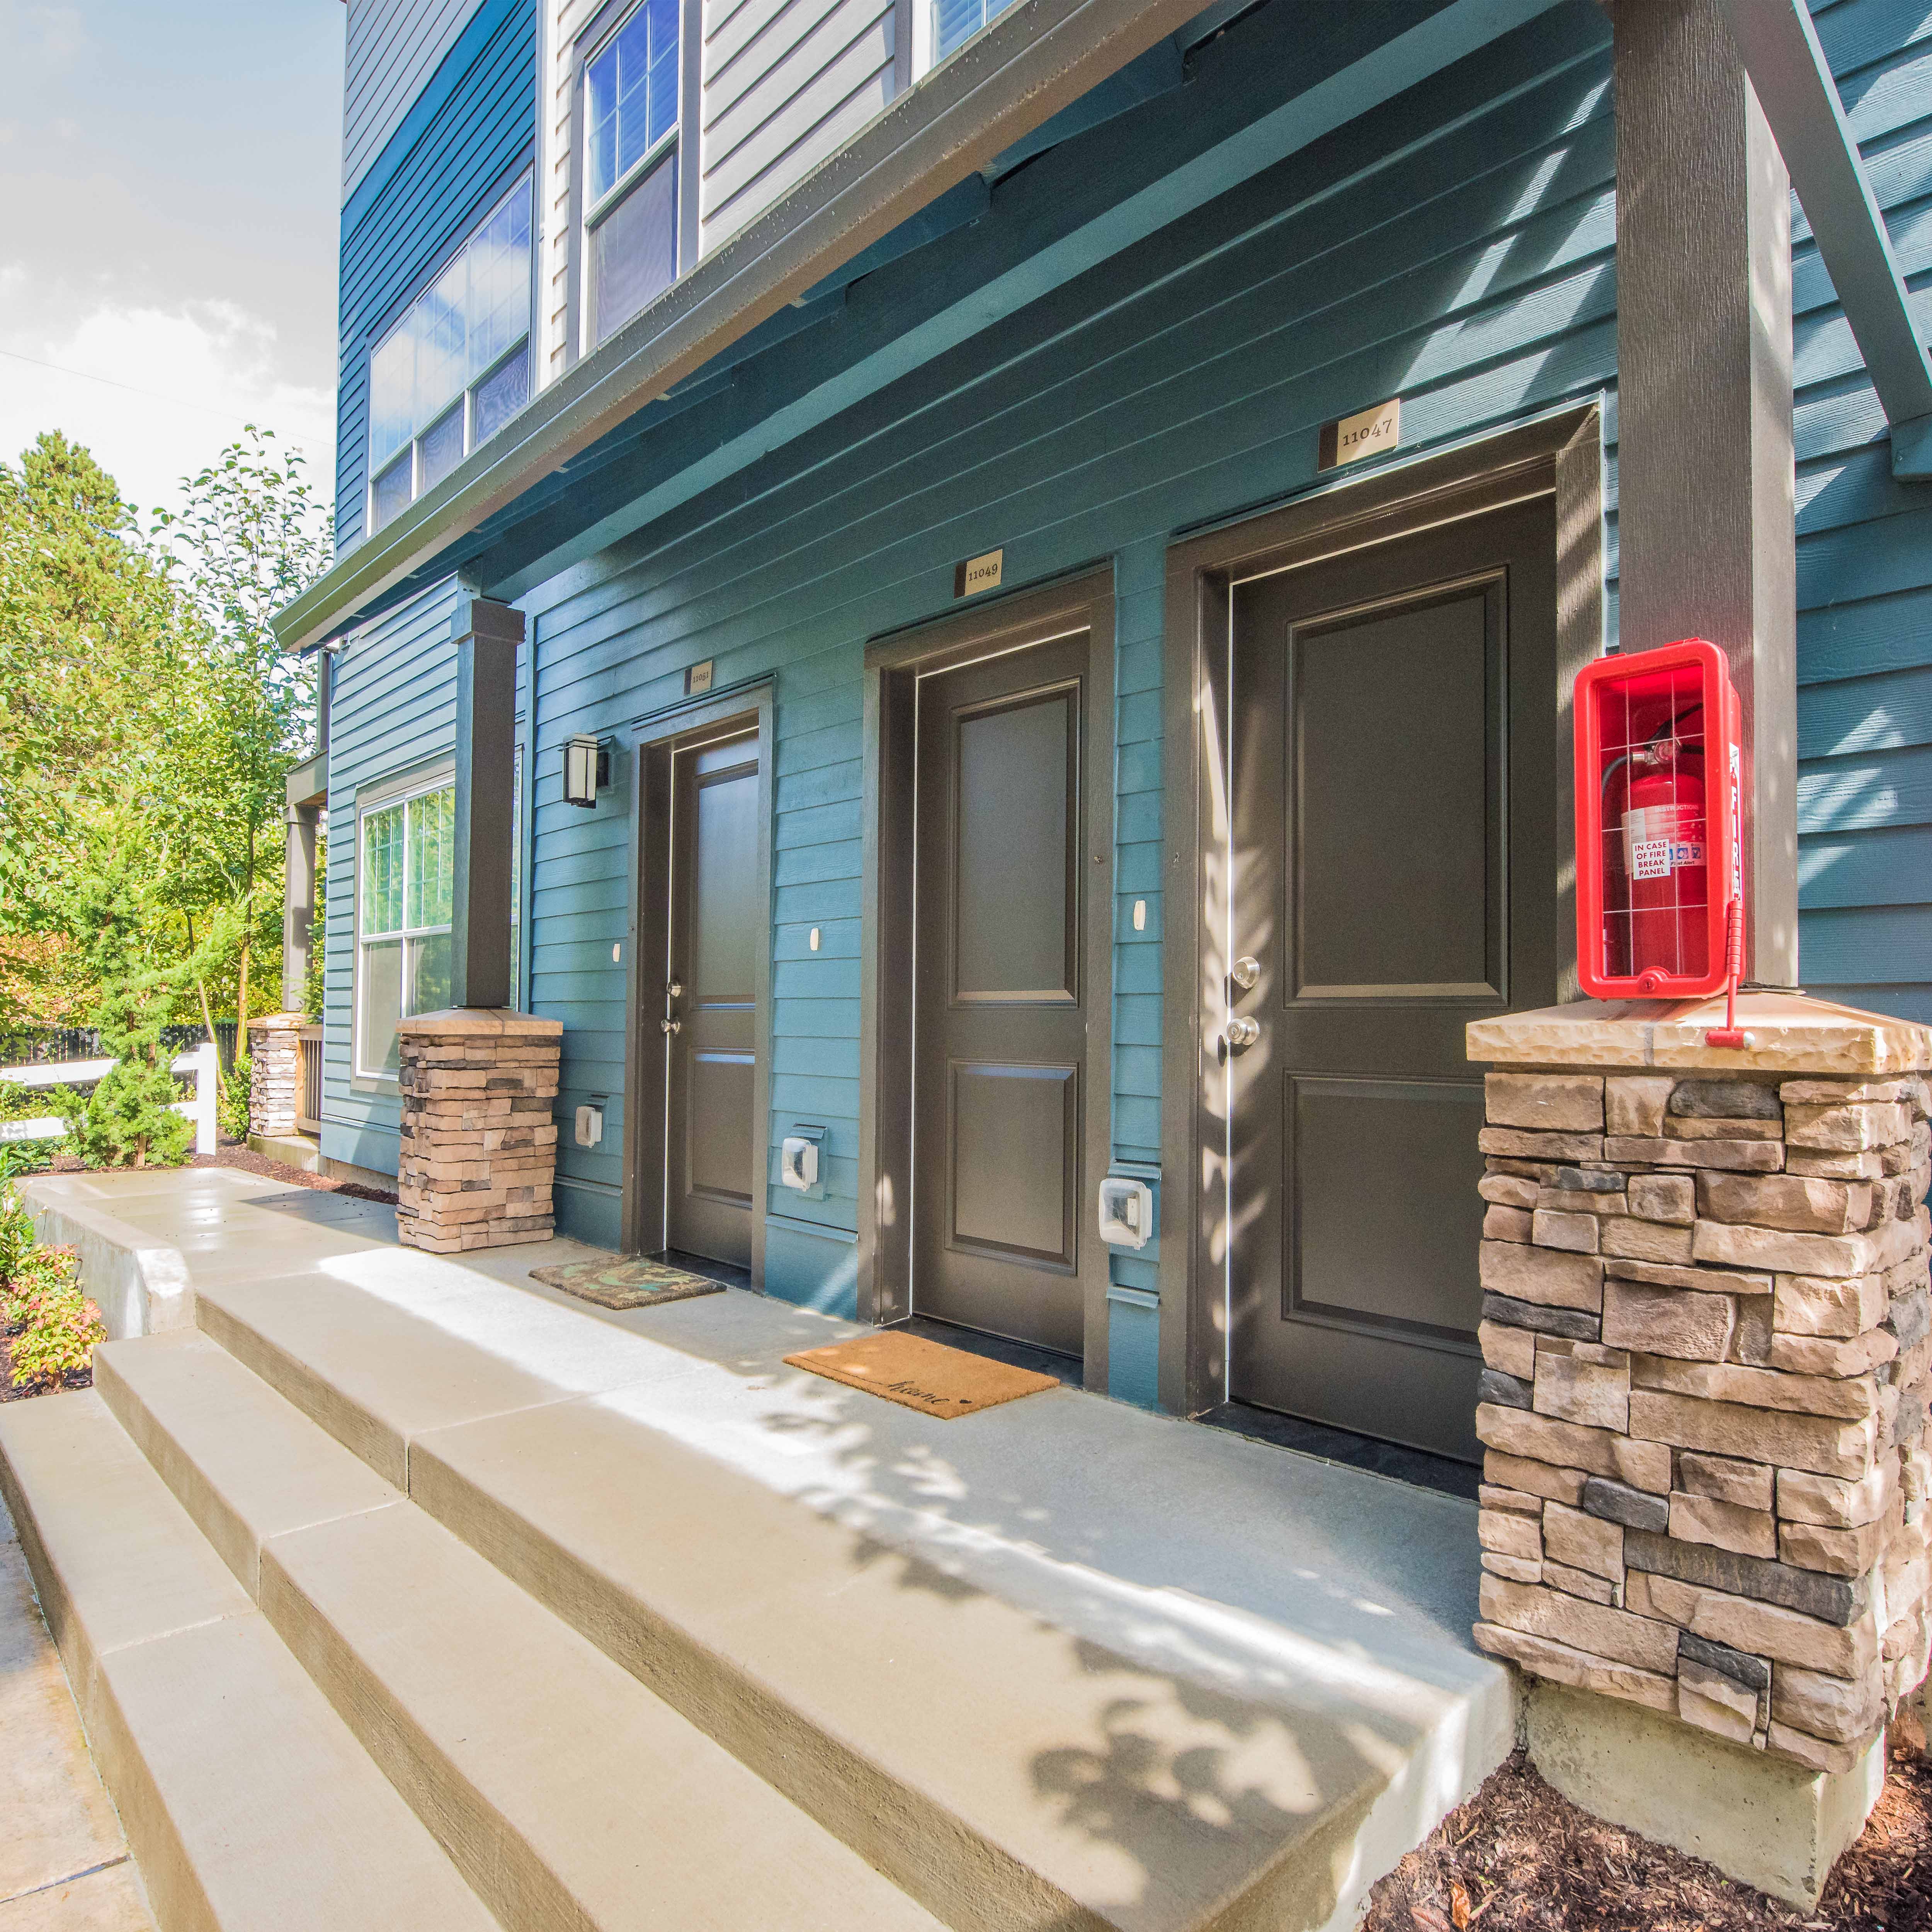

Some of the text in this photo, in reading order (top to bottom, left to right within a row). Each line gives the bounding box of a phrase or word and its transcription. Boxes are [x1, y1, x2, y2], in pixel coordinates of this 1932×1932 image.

[1343, 418, 1393, 447] 11047
[968, 563, 998, 582] 11049
[693, 671, 709, 683] 11051
[1731, 786, 1740, 891] FIRE
[1646, 841, 1667, 850] CASE
[1650, 850, 1666, 858] FIRE
[1638, 859, 1665, 868] BREAK
[1639, 867, 1665, 876] PANEL
[886, 1380, 950, 1405] home
